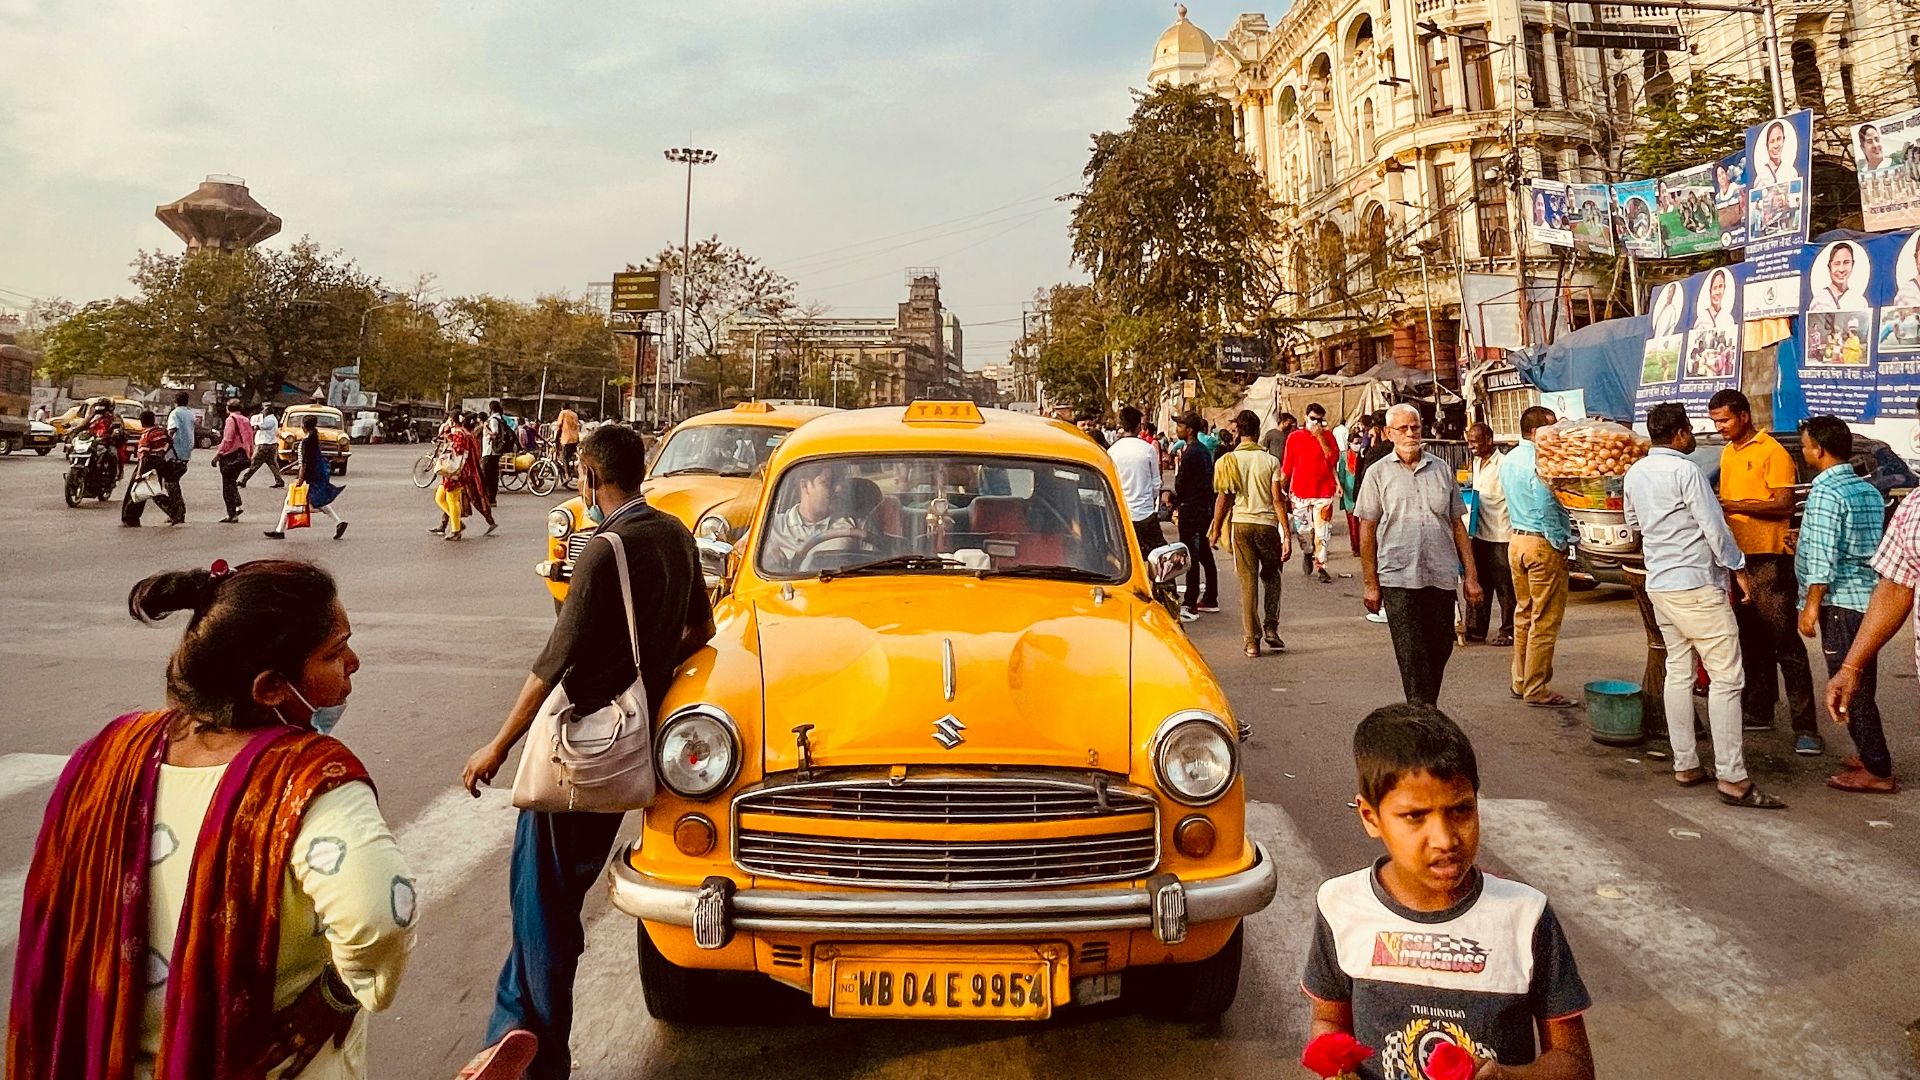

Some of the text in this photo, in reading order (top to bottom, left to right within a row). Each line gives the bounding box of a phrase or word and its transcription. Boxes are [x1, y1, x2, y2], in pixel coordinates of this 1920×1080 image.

[918, 406, 971, 416] TAXI
[857, 970, 1044, 1008] WB 04 E 9954
[1411, 1004, 1429, 1015] THE
